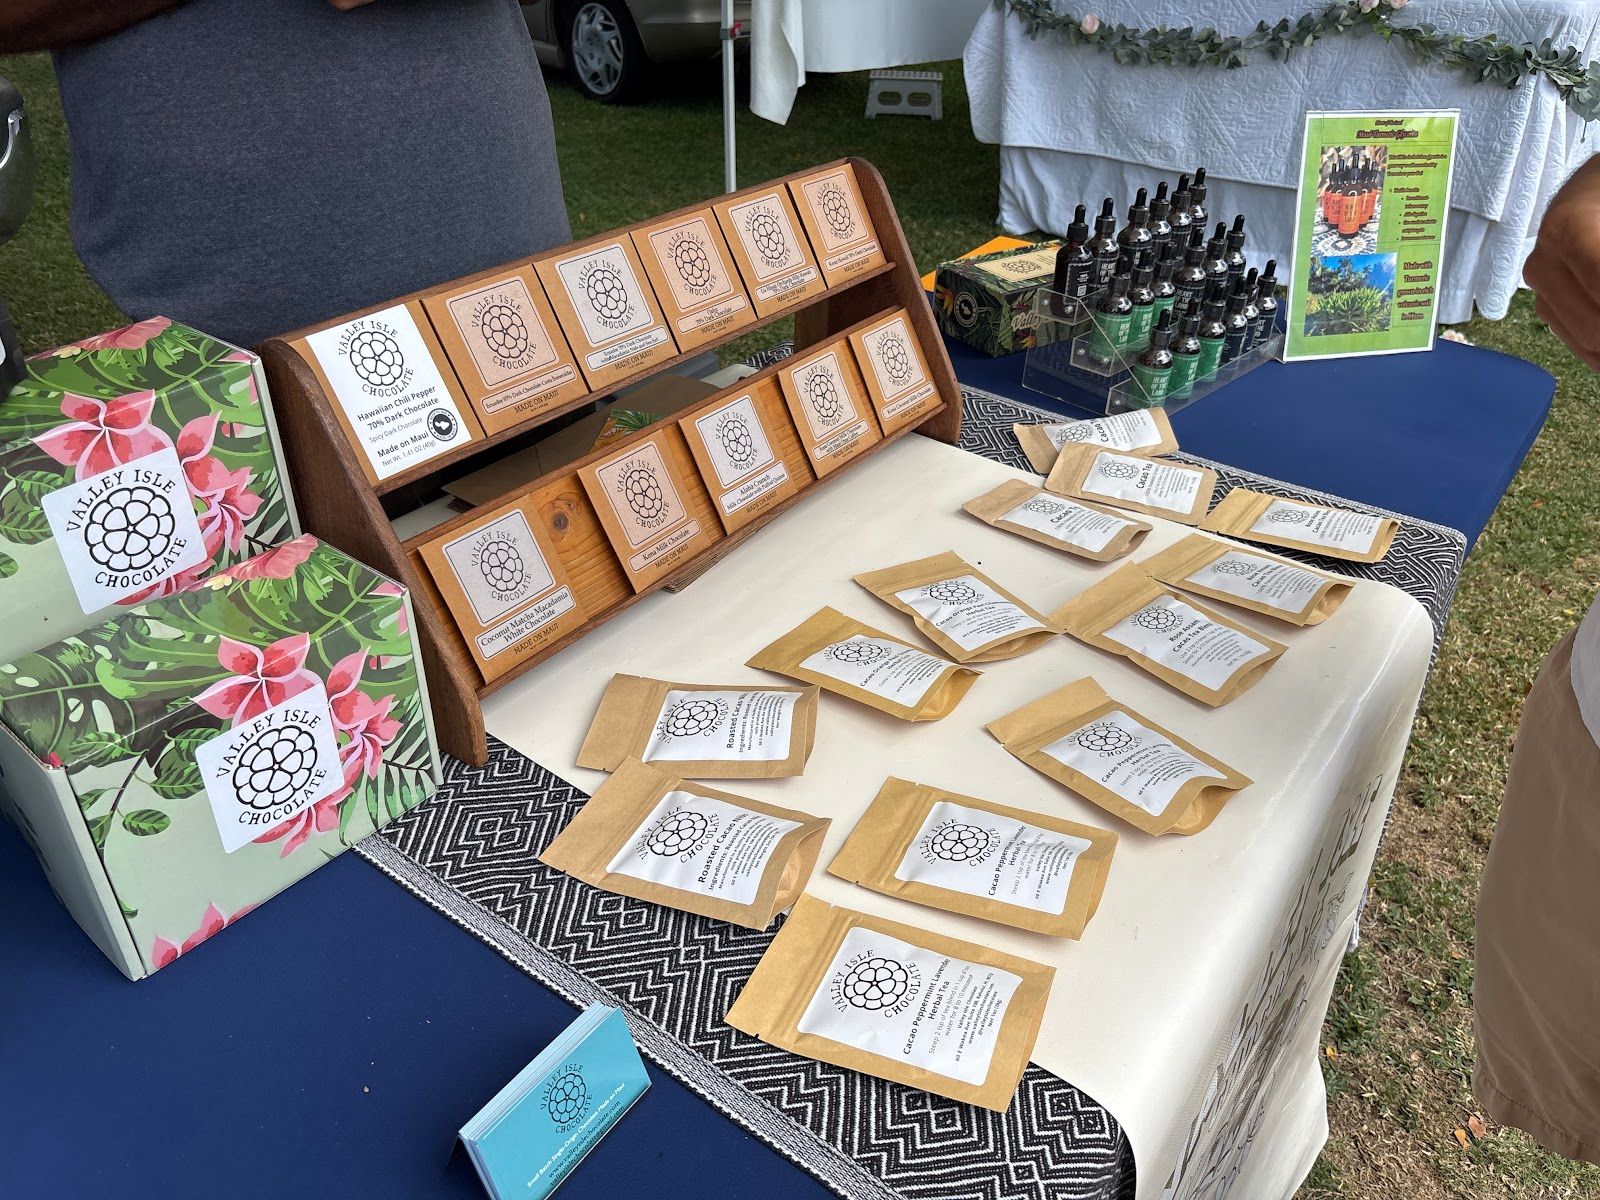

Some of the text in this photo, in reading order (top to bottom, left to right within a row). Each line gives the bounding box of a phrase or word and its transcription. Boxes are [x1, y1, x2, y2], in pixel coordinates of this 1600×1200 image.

[745, 206, 779, 232] VALLEY ISLE
[667, 231, 705, 259] VALLEY ISLE
[760, 247, 791, 269] CHOCOLATE
[578, 260, 623, 290] VALLEY ISLE
[684, 274, 716, 296] CHOCOLATE
[472, 294, 523, 328] VALLEY ISLE
[596, 305, 635, 329] CHOCOLATE
[339, 321, 398, 355] VALLEY ISLE
[493, 342, 537, 370] CHOCOLATE
[615, 359, 630, 370] MADE
[362, 367, 414, 397] CHOCOLATE
[804, 366, 834, 393] VALLEY ISLE
[358, 386, 436, 422] Hawaiian Chili Pepper
[367, 396, 439, 430] 70% Dark Chocolate
[514, 401, 533, 413] MADE
[543, 390, 559, 400] MAUI
[369, 417, 423, 444] Spicy Dark Chocolate
[716, 412, 748, 440] VALLEY ISLE
[378, 431, 429, 458] Made on Maui
[729, 448, 758, 470] CHOCOLATE
[618, 460, 656, 493] VALLEY ISLE
[741, 474, 770, 495] Aloha Crunch
[1136, 472, 1149, 489] Cacao
[67, 469, 177, 533] VALLEY ISLE
[636, 501, 669, 528] CHOCOLATE
[1050, 510, 1072, 523] Cacao
[472, 531, 518, 567] VALLEY ISLE
[643, 530, 689, 560] Kona Milk Chocolate
[94, 535, 187, 589] CHOCOLATE
[491, 572, 532, 602] CHOCOLATE
[481, 592, 569, 646] Coconut Matcha Macadamia
[504, 609, 555, 642] White Chocolate
[936, 616, 953, 627] Cacao
[952, 606, 973, 617] Orange
[1169, 620, 1200, 642] Rose Assam
[514, 623, 559, 654] MADE ON MAUI
[1173, 636, 1191, 653] Cacao
[860, 661, 889, 686] Cacao Orange
[656, 698, 687, 745] VALLEY ISLE
[727, 700, 743, 748] Roasted Cacao
[216, 709, 322, 779] VALLEY ISLE
[1131, 753, 1151, 765] Herbal
[1101, 747, 1149, 782] Cacao Peppermint
[238, 766, 327, 826] CHOCOLATE
[637, 806, 682, 861] VALLEY ISLE
[680, 813, 720, 863] CHOCOLATE
[920, 818, 958, 865] VALLEY ISLE
[969, 828, 1001, 867] CHOCOLATE
[698, 823, 736, 883] Roasted Cacao
[709, 852, 728, 890] Ingredients:
[725, 830, 741, 850] Roasted
[1008, 846, 1021, 866] Herbal
[989, 842, 1014, 896] Cacao Peppermint
[830, 950, 875, 1013] VALLEY ISLE
[884, 962, 922, 1018] CHOCOLATE
[928, 981, 950, 1020] Herbal Tea
[903, 979, 936, 1054] Cacao Peppermint
[929, 1036, 939, 1054] Steep
[541, 1064, 584, 1110] VALLEY ISLE
[555, 1094, 592, 1134] CHOCOLATE
[527, 1173, 540, 1187] Small
